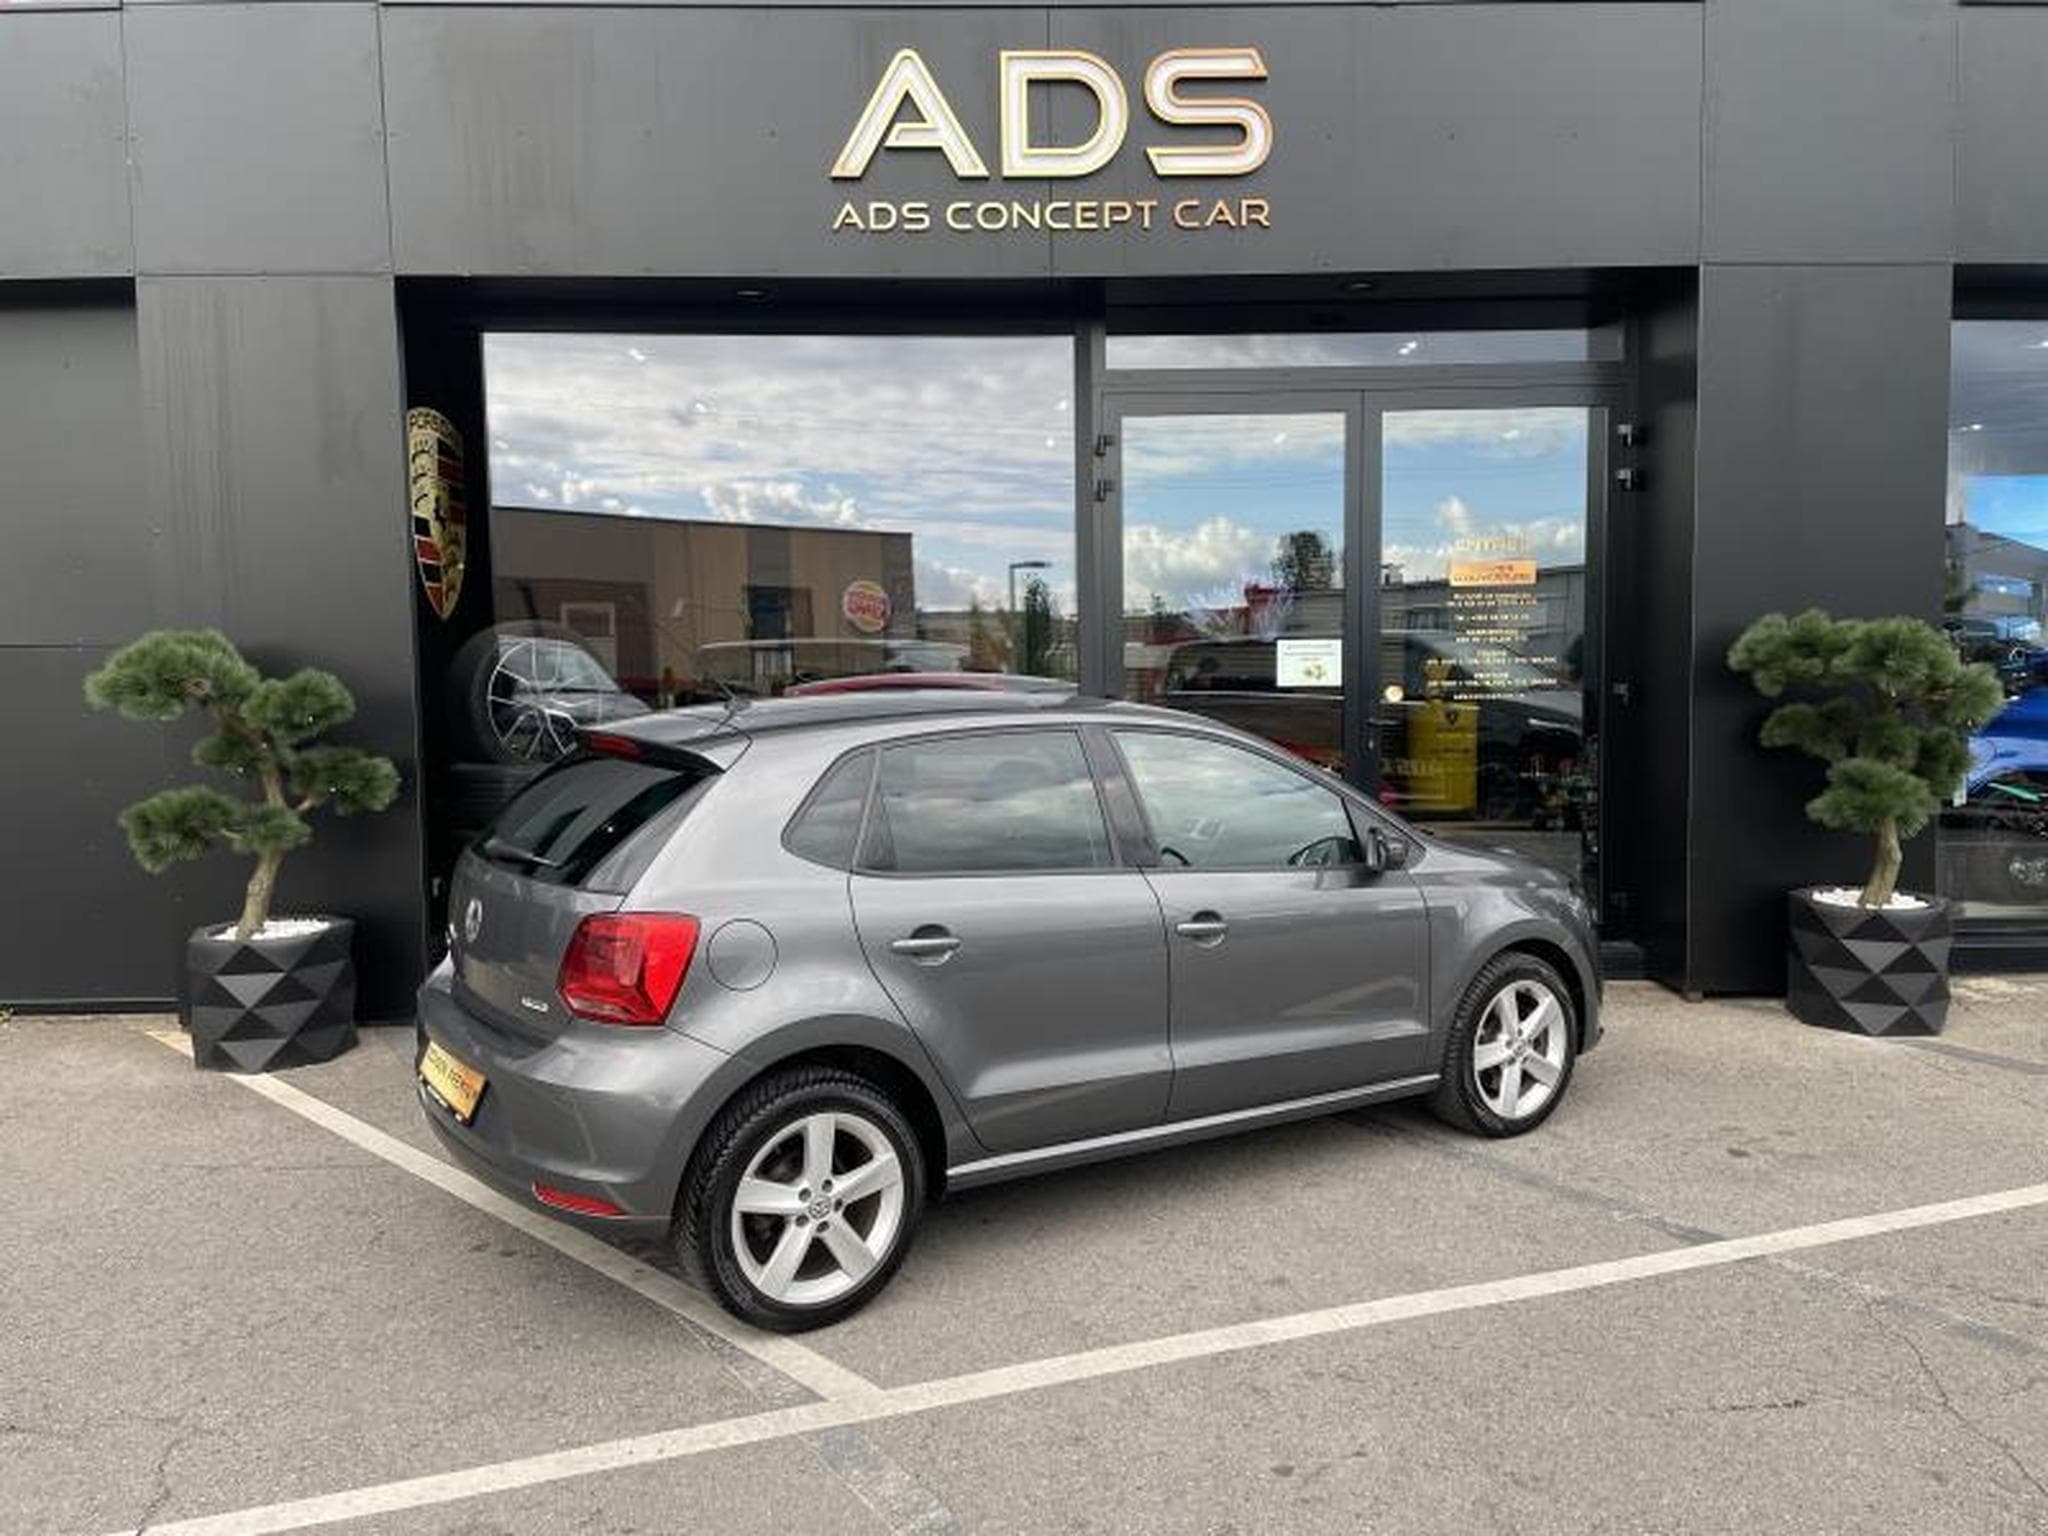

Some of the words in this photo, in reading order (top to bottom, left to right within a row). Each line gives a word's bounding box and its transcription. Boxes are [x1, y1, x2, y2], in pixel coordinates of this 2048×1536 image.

[830, 48, 1274, 178] ADS
[832, 201, 930, 232] ADS
[945, 198, 1158, 230] CONCEPT
[1174, 197, 1271, 228] CAR
